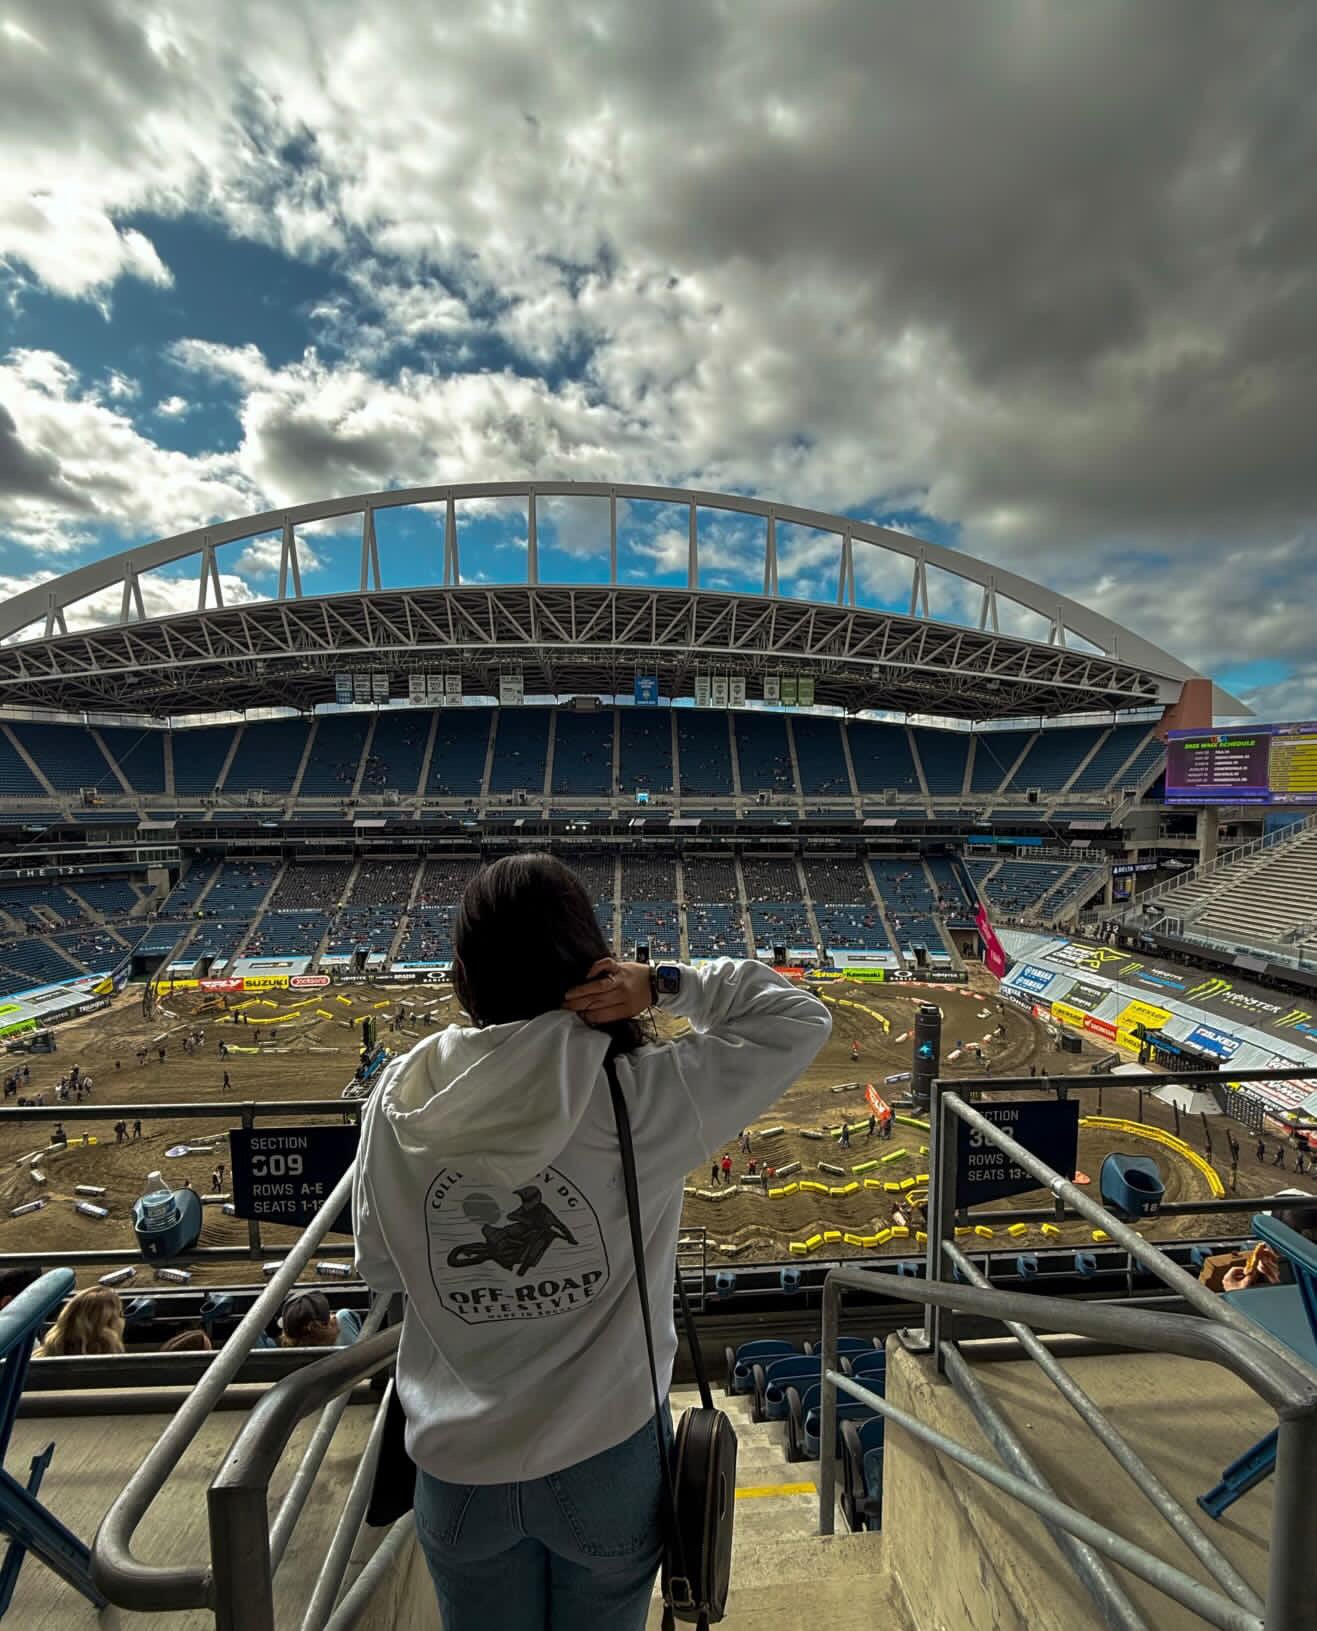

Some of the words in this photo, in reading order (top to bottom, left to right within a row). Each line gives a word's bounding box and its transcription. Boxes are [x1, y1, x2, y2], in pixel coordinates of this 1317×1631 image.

[16, 869, 48, 878] THE
[245, 977, 288, 987] SUZUKI
[1222, 991, 1281, 1013] MONSTER
[1196, 1027, 1240, 1049] FALKEN
[982, 1109, 1019, 1121] CTION
[250, 1136, 308, 1150] SECTION
[968, 1153, 1004, 1167] ROWS
[968, 1168, 1006, 1181] SEATS
[1009, 1168, 1033, 1179] 13-2
[252, 1183, 294, 1197] ROWS
[301, 1182, 324, 1195] A-E
[254, 1200, 297, 1214] SEATS
[449, 1270, 603, 1305] OFF-ROAD
[457, 1286, 595, 1315] LIFESTYLE
